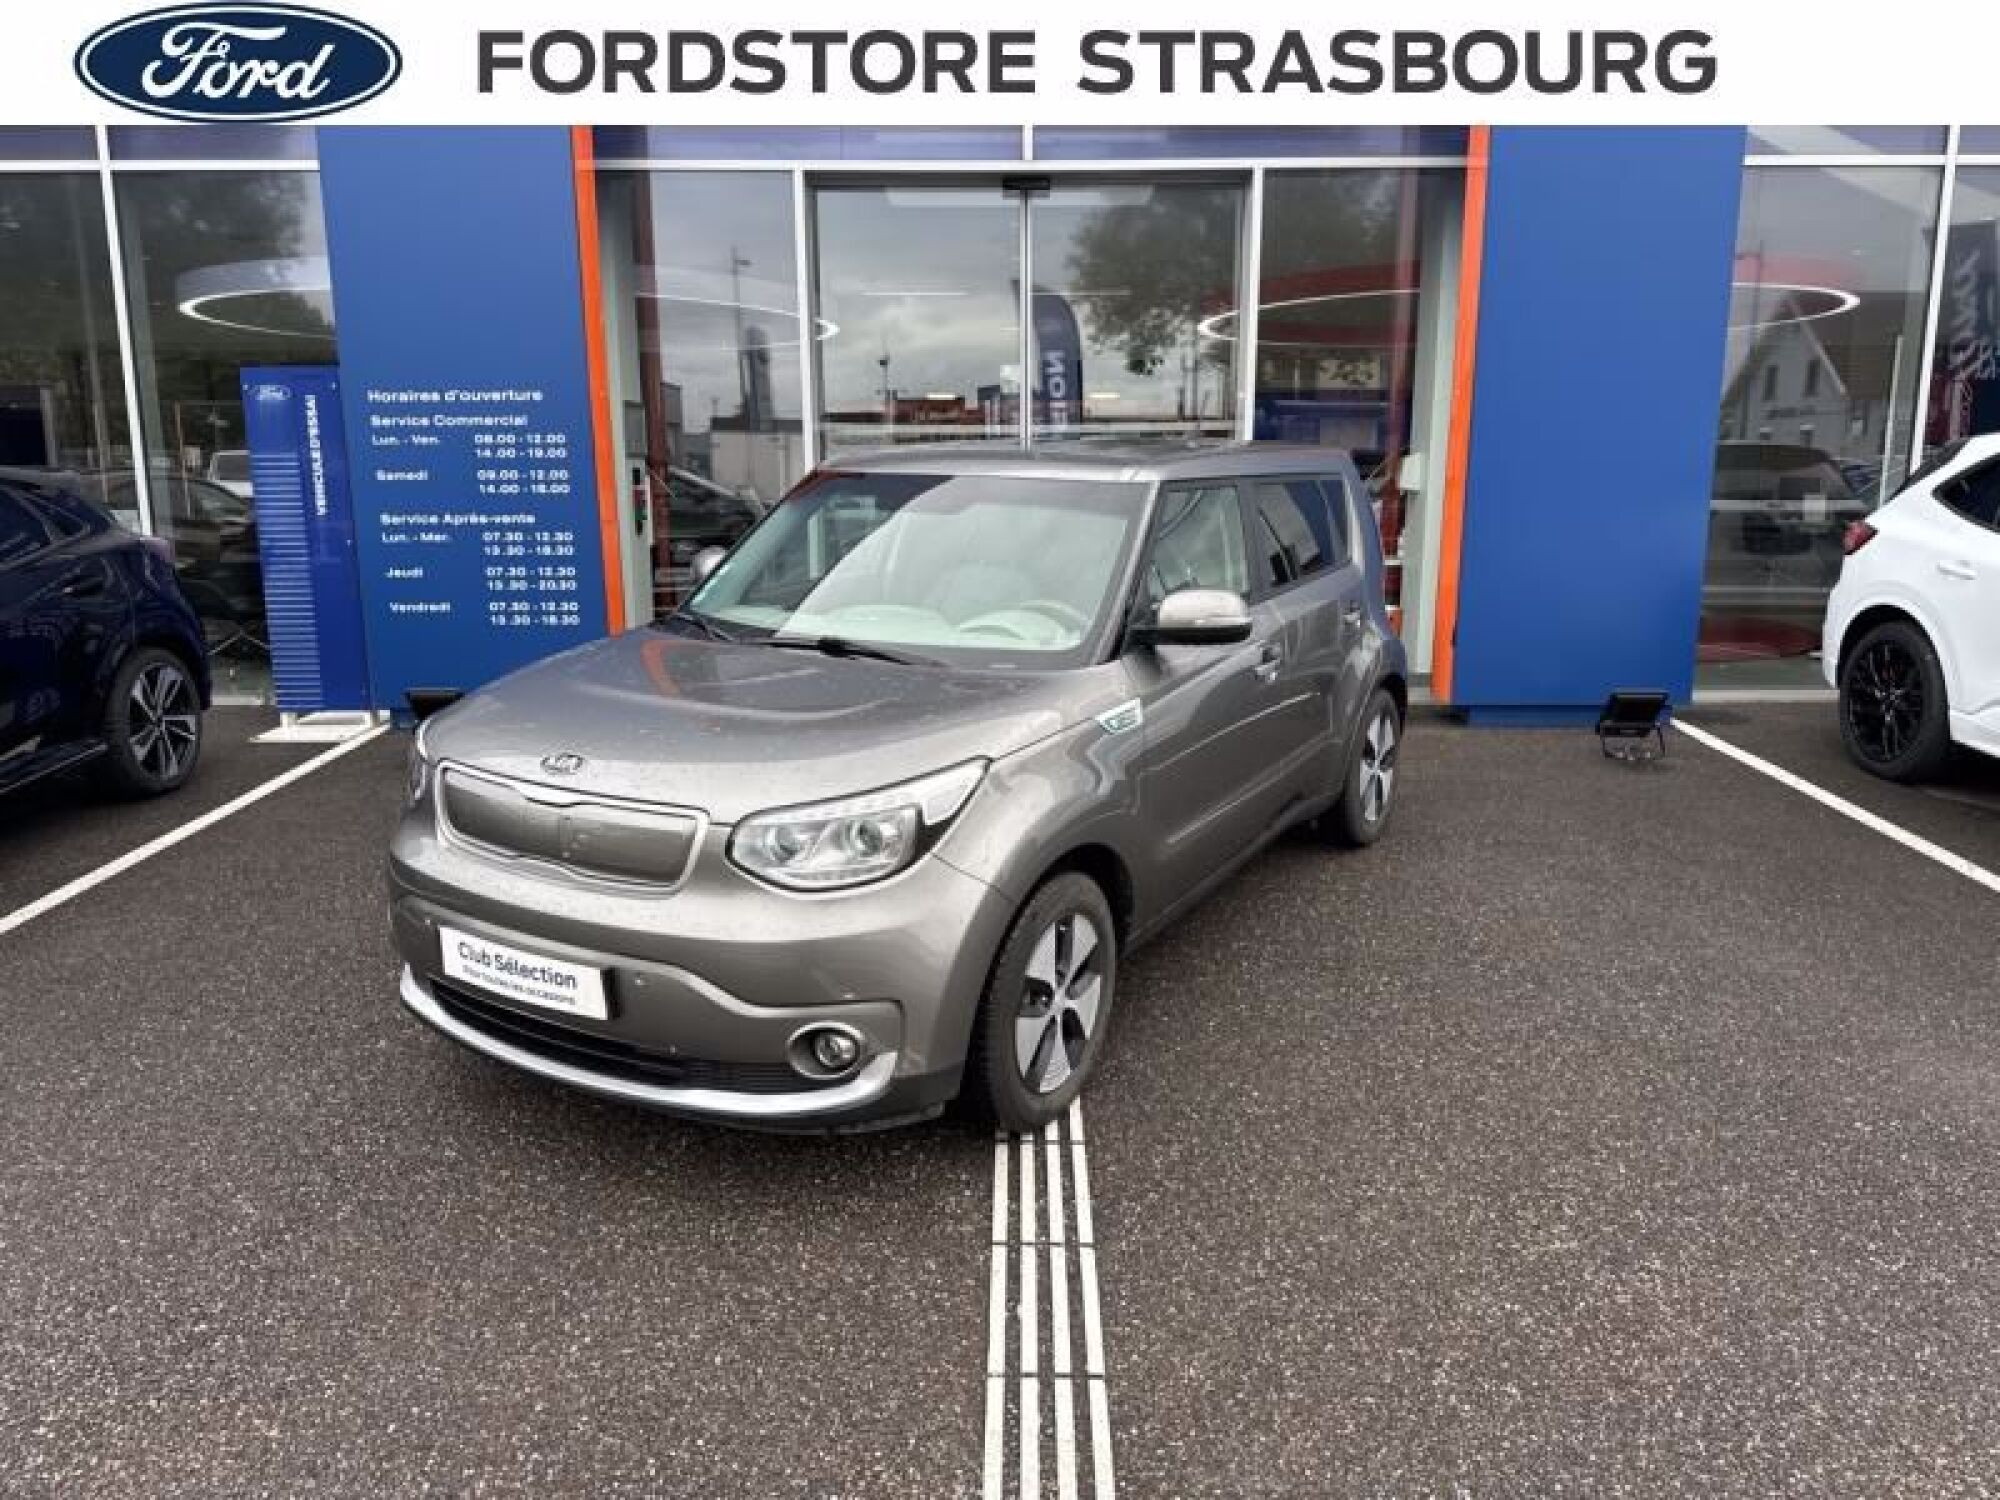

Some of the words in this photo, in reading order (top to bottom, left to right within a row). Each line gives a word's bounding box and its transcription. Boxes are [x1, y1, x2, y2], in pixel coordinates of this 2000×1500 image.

[367, 389, 441, 403] Horaires
[444, 389, 543, 403] d'ouverture
[371, 414, 430, 427] Service
[433, 414, 528, 427] Commercial
[372, 434, 400, 446] Lun.
[410, 434, 441, 446] Ven.
[474, 433, 516, 446] 08.00
[526, 433, 566, 446] 12.00
[475, 447, 516, 459] 14.00
[376, 470, 428, 481] Samedi
[477, 469, 518, 481] 09.00
[529, 469, 569, 481] 12.00
[479, 484, 521, 495] 14.00
[380, 513, 439, 526] Service
[442, 512, 536, 528] Après-vente
[482, 532, 524, 543] 07.30
[385, 567, 423, 578] Jeudi
[486, 566, 526, 578] 07.30
[389, 602, 451, 613] Vendredi
[489, 601, 530, 612] 07.30
[458, 941, 491, 967] Club
[494, 954, 578, 990] Sélection
